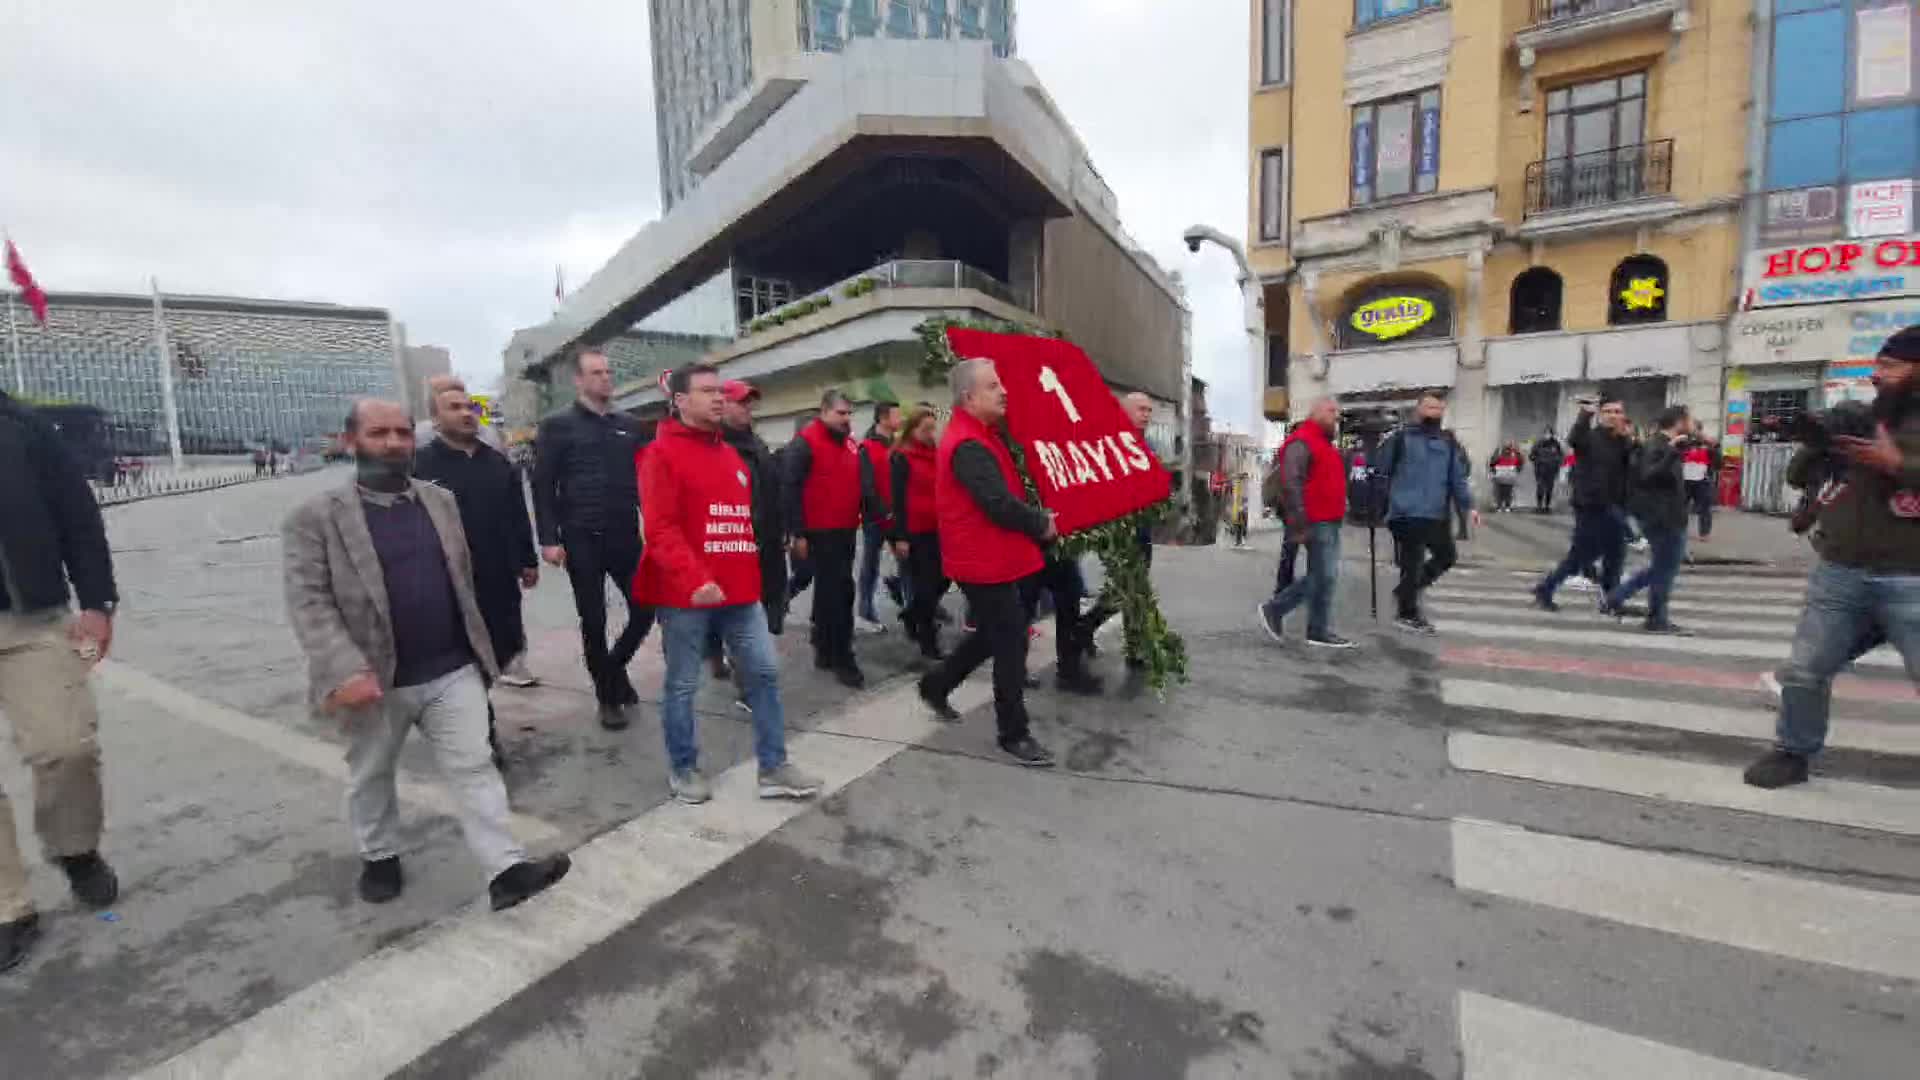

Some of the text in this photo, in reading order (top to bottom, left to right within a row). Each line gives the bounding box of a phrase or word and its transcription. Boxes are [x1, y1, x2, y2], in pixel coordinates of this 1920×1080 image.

[1762, 243, 1863, 279] HOP
[1038, 365, 1083, 424] 1
[1032, 430, 1151, 493] MAYIS
